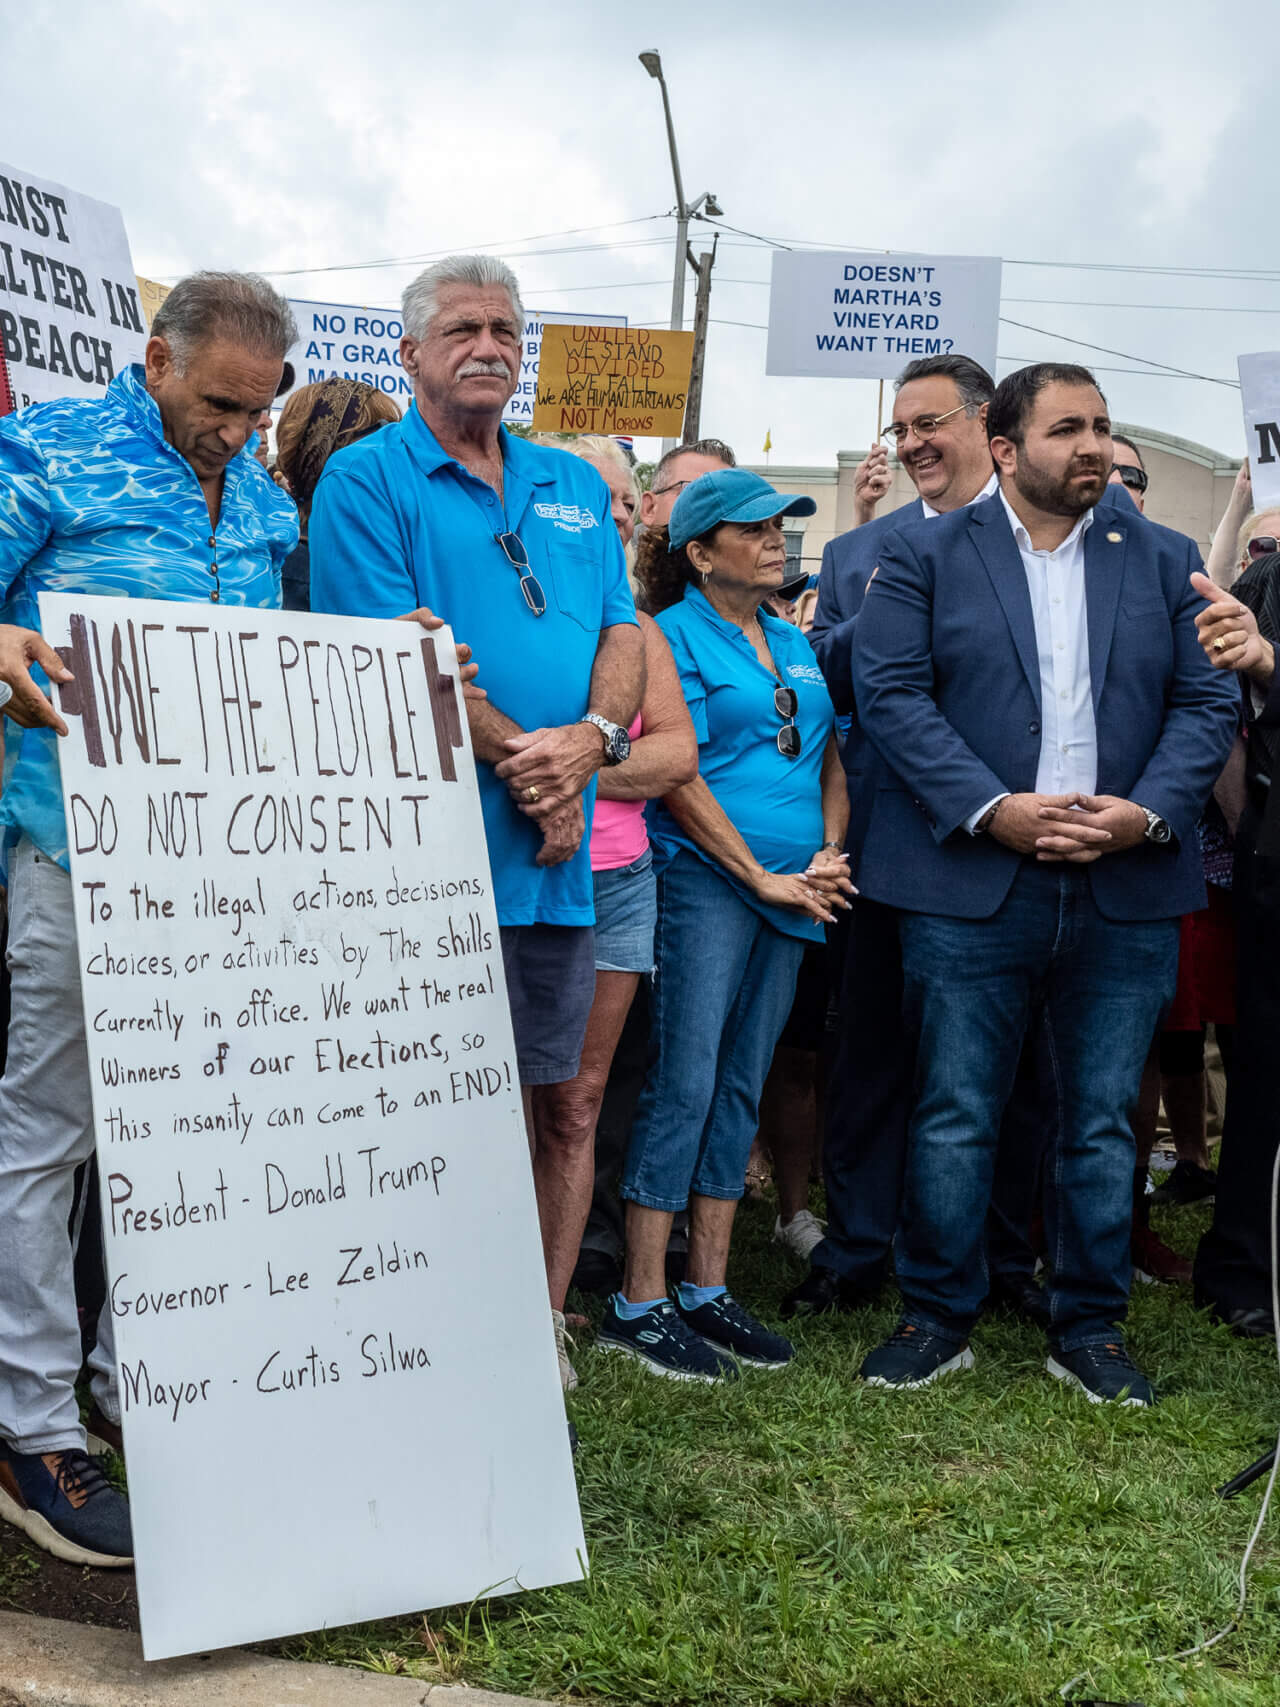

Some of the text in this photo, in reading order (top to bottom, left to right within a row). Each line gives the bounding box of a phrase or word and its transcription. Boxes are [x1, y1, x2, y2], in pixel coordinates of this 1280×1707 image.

[844, 265, 935, 283] DOESN'T
[101, 278, 144, 334] IN
[834, 288, 942, 307] MARTHA'S
[313, 313, 403, 339] NO ROO
[833, 311, 939, 330] VINEYARD
[573, 325, 650, 345] UNITED
[816, 335, 954, 356] WANT THEM?
[305, 341, 403, 367] AT GRAC
[563, 340, 663, 361] WE STAND
[566, 357, 664, 379] DIVIDED
[567, 373, 658, 394] WE FALL
[559, 389, 581, 406] ARE
[587, 388, 685, 409] HUMANITARIANS
[560, 407, 600, 430] NOT
[91, 617, 428, 782] WE THE PEOPLE
[70, 791, 429, 858] DO NOT CONSENT
[82, 864, 485, 936] To the illegal actions, decisions,
[184, 953, 210, 974] or
[223, 932, 319, 969] activities
[340, 931, 369, 980] by
[437, 912, 493, 958] shills
[204, 1006, 222, 1029] in
[237, 988, 309, 1028] office.
[321, 981, 351, 1021] We
[365, 976, 410, 1016] want
[420, 979, 451, 1008] the
[458, 963, 494, 1000] real
[203, 1042, 230, 1076] of
[250, 1055, 295, 1075] our
[315, 1030, 449, 1073] Elections,
[462, 1033, 485, 1051] so
[173, 1092, 253, 1145] insanity
[267, 1106, 304, 1127] can
[375, 1086, 398, 1117] to
[414, 1088, 442, 1107] an
[449, 1061, 512, 1104] END!
[108, 1168, 228, 1237] President
[265, 1152, 346, 1214] Donald
[358, 1147, 447, 1198] Trump
[112, 1273, 229, 1317] Governor
[267, 1261, 310, 1296] Lee
[337, 1241, 429, 1286] Zeldin
[122, 1360, 211, 1423] Mayor
[256, 1345, 341, 1393] Curtis
[361, 1331, 431, 1378] Silwa
